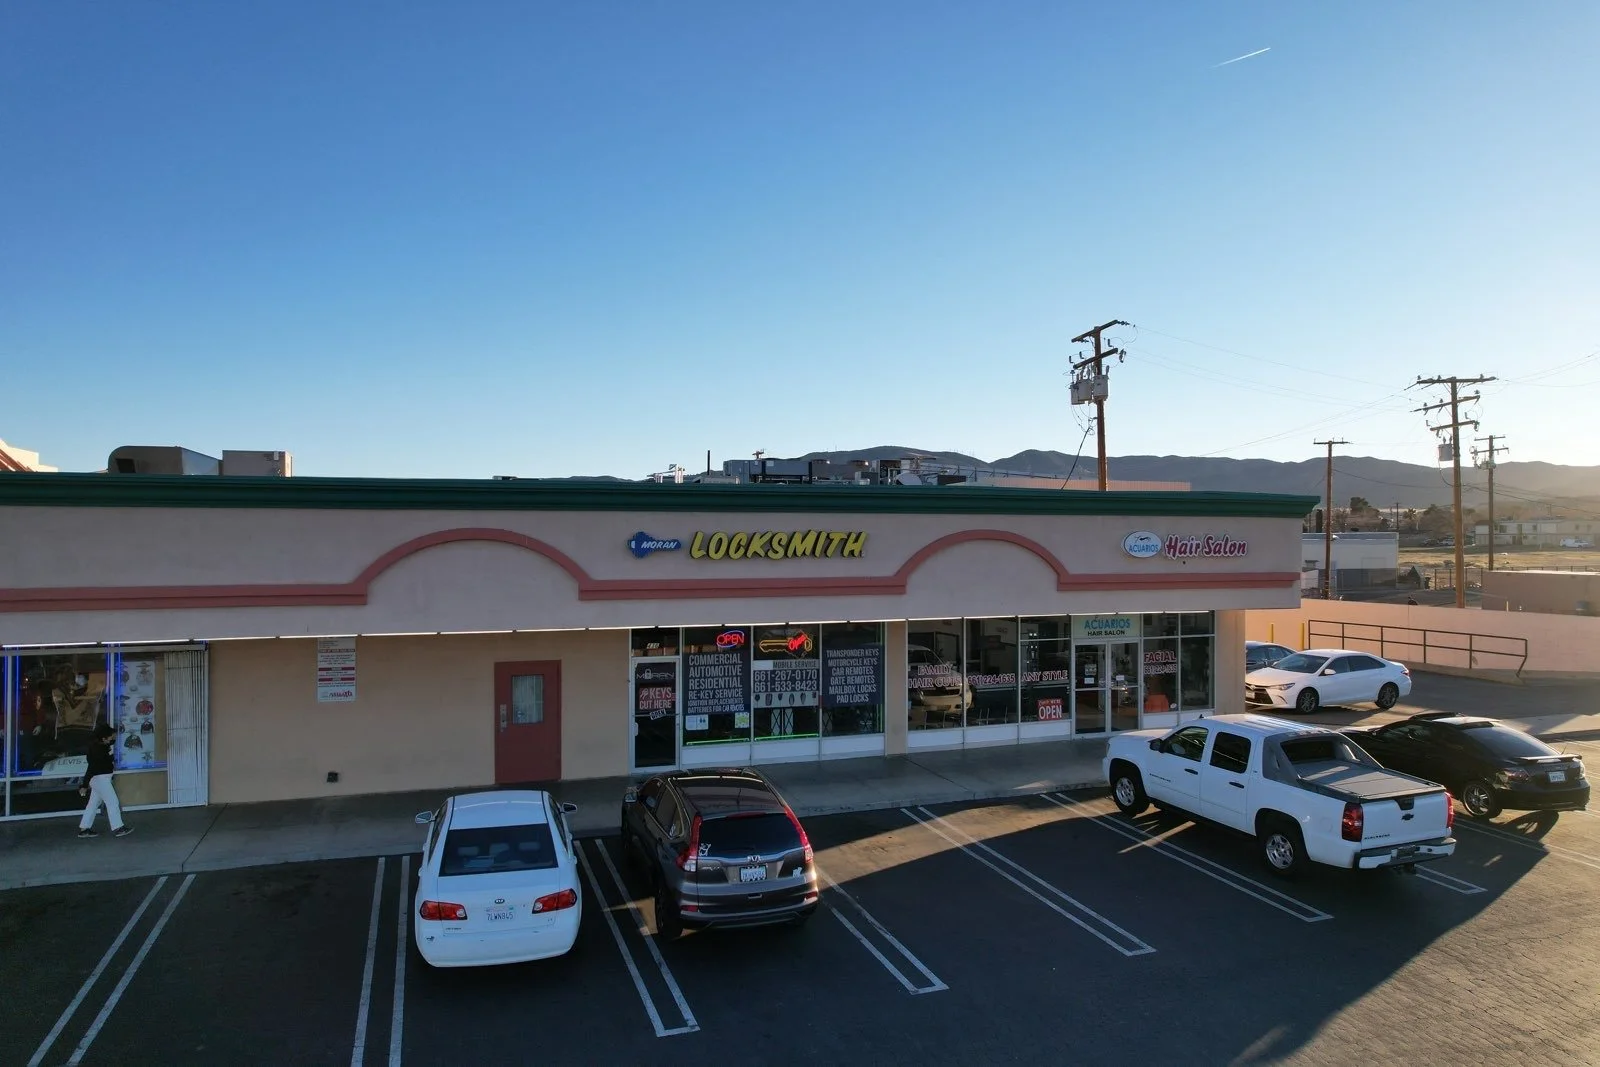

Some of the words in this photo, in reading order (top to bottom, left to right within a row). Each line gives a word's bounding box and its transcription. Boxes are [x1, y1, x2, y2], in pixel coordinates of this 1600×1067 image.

[641, 540, 678, 549] MORAN
[690, 529, 867, 560] LOCKSMITH
[1128, 544, 1159, 553] ACUARIOS
[1164, 534, 1201, 560] Hair
[1203, 534, 1247, 557] Salon
[1084, 618, 1131, 630] ACUARIOS
[717, 633, 744, 646] OPEN
[826, 650, 864, 658] TRANSPONDER
[865, 648, 880, 656] KEYS
[1143, 651, 1177, 663] FACIAL
[688, 653, 743, 666] COMMERCIAL
[773, 661, 793, 669] MOBILE
[795, 660, 817, 668] SERVICE
[827, 659, 863, 667] MOTORCYCLE
[863, 658, 878, 666] KEYS
[688, 665, 742, 678] AUTOMOTIVE
[831, 667, 845, 676] CAR
[845, 666, 874, 675] REMOTES
[918, 664, 953, 675] FAMILY
[754, 670, 818, 681] 661-267-0170
[830, 676, 846, 686] GATE
[846, 675, 875, 684] REMOTES
[1021, 671, 1041, 682] ANY
[1042, 670, 1068, 681] STYLE
[688, 678, 743, 689] RESIDENTIAL
[754, 681, 818, 692] 661-533-8423
[908, 677, 934, 688] HAIR
[649, 687, 672, 699] KEYS
[688, 690, 714, 700] RE-KEY
[715, 688, 743, 698] SERVICE
[828, 685, 857, 694] MAILBOX
[857, 684, 877, 693] LOCKS
[836, 694, 849, 703] PAD
[850, 693, 870, 702] LOCKS
[639, 701, 653, 710] CUT
[654, 699, 672, 709] HERE
[1038, 705, 1062, 719] OPEN
